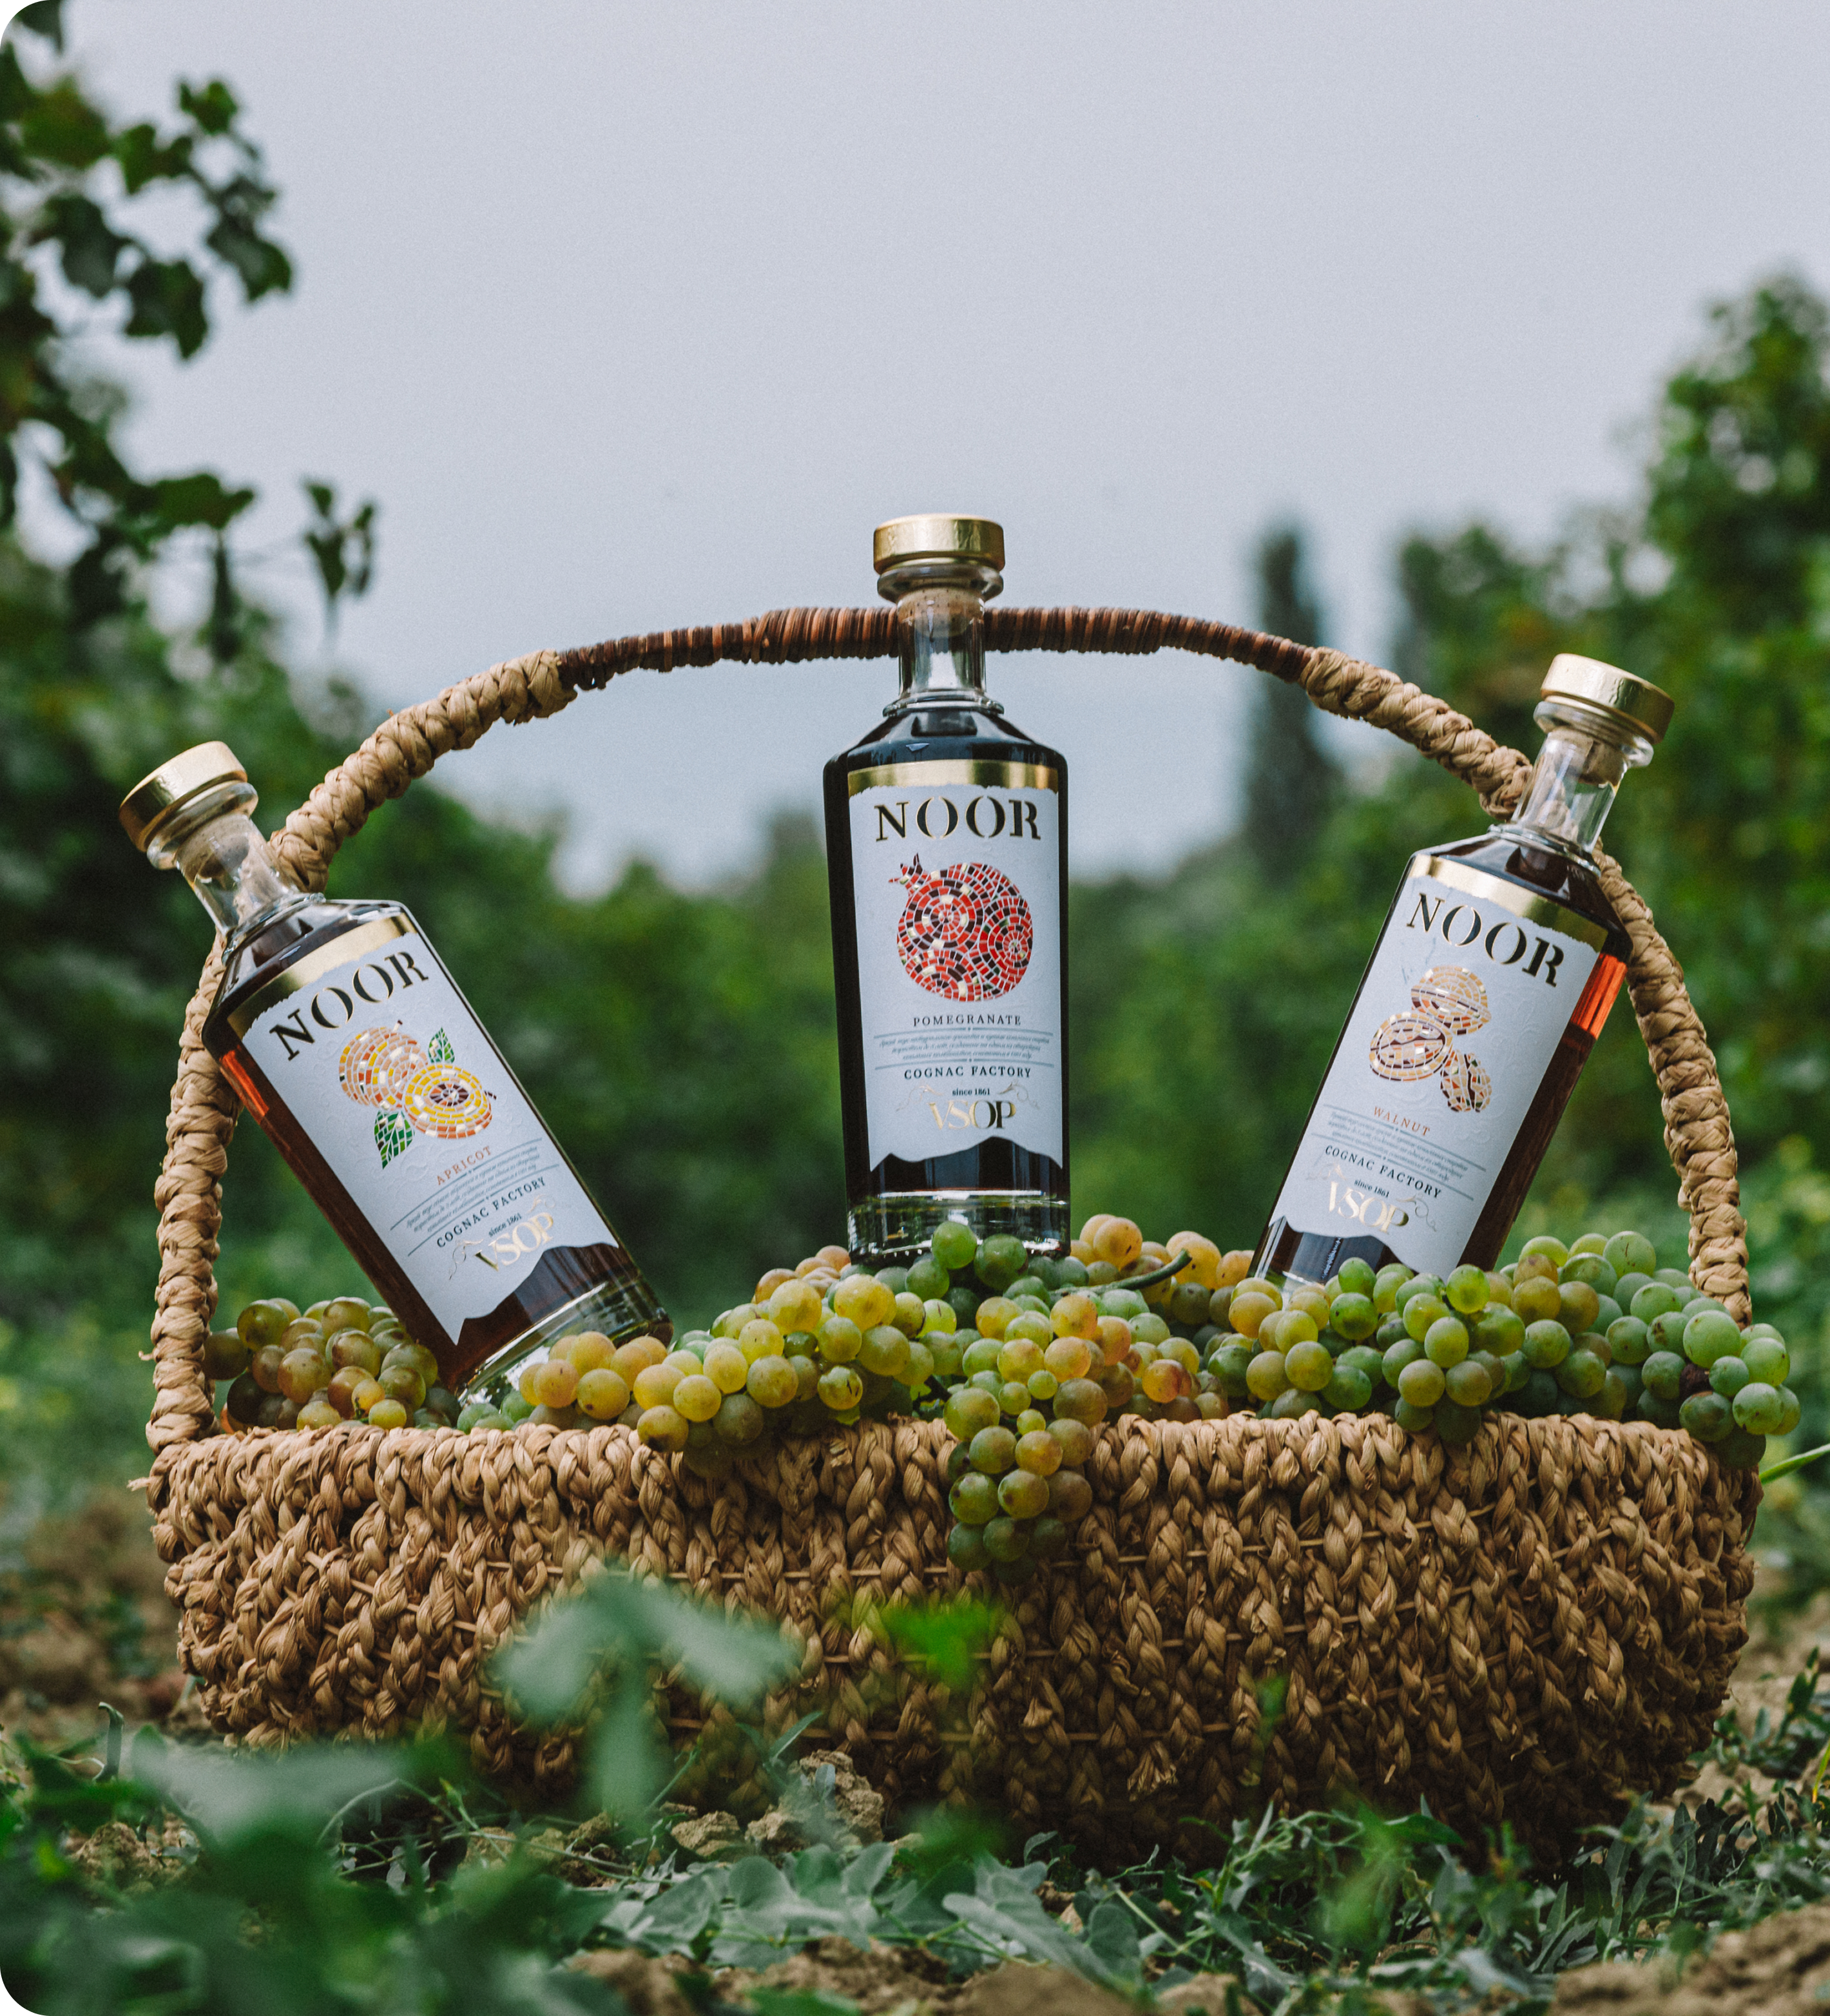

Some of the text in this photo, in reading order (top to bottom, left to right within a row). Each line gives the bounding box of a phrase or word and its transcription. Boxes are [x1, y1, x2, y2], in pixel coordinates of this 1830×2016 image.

[874, 795, 1041, 842] NOOR
[1406, 893, 1565, 987] NOOR
[269, 951, 429, 1061] NOOR
[913, 1013, 1021, 1027] POMEGRANATE
[904, 1065, 1031, 1080] COGNAC FACTORY
[952, 1087, 990, 1096] since 1861
[927, 1100, 1017, 1130] VSOP
[1374, 1106, 1430, 1136] WALNUT
[436, 1146, 492, 1186] APRICOT
[1325, 1145, 1375, 1170] COGNAC
[1379, 1165, 1441, 1199] FACTORY
[1329, 1181, 1409, 1234] VSOP
[1354, 1179, 1390, 1198] since 1861
[437, 1207, 489, 1248] COGNAC
[492, 1177, 546, 1210] FACTORY
[488, 1212, 523, 1237] since 1861
[474, 1212, 554, 1272] VSOP
